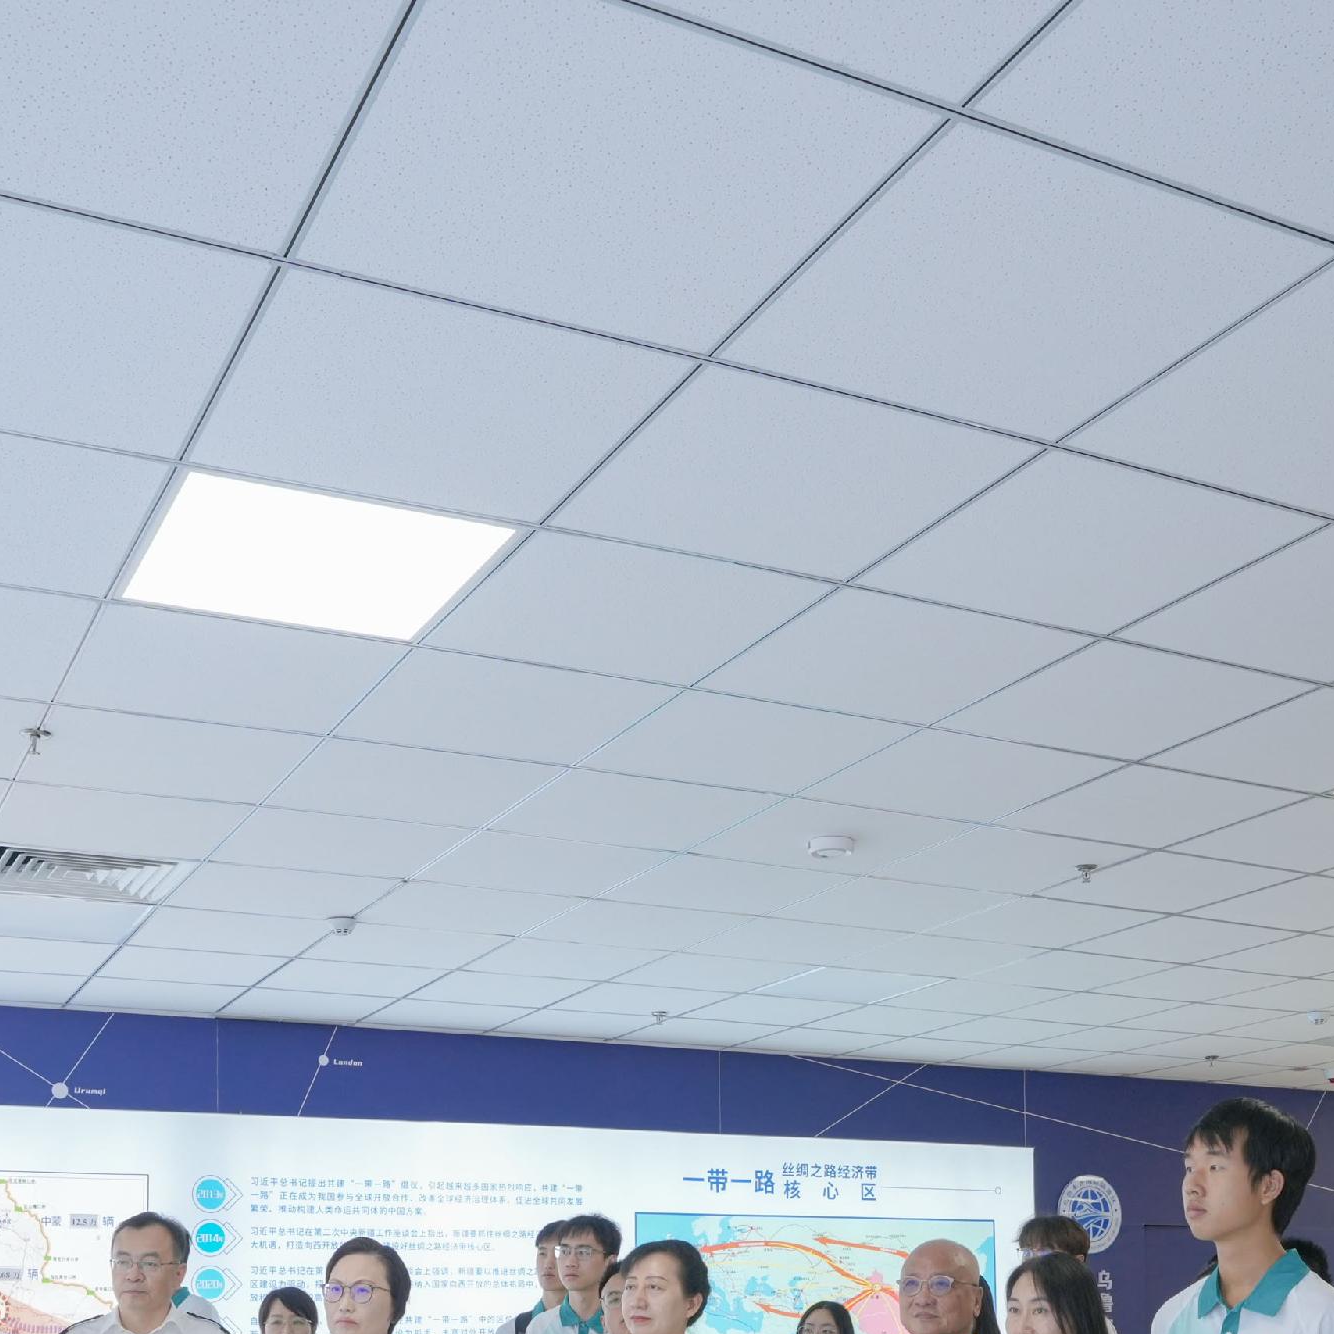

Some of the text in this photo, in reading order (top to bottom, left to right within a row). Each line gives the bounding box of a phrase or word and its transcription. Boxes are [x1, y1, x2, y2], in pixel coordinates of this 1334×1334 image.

[74, 1087, 106, 1097] Urumqi
[782, 1163, 878, 1180] 丝绸之路经济带
[682, 1168, 776, 1195] 一带一路
[783, 1179, 878, 1201] 核心区
[41, 1215, 62, 1226] 中蒙
